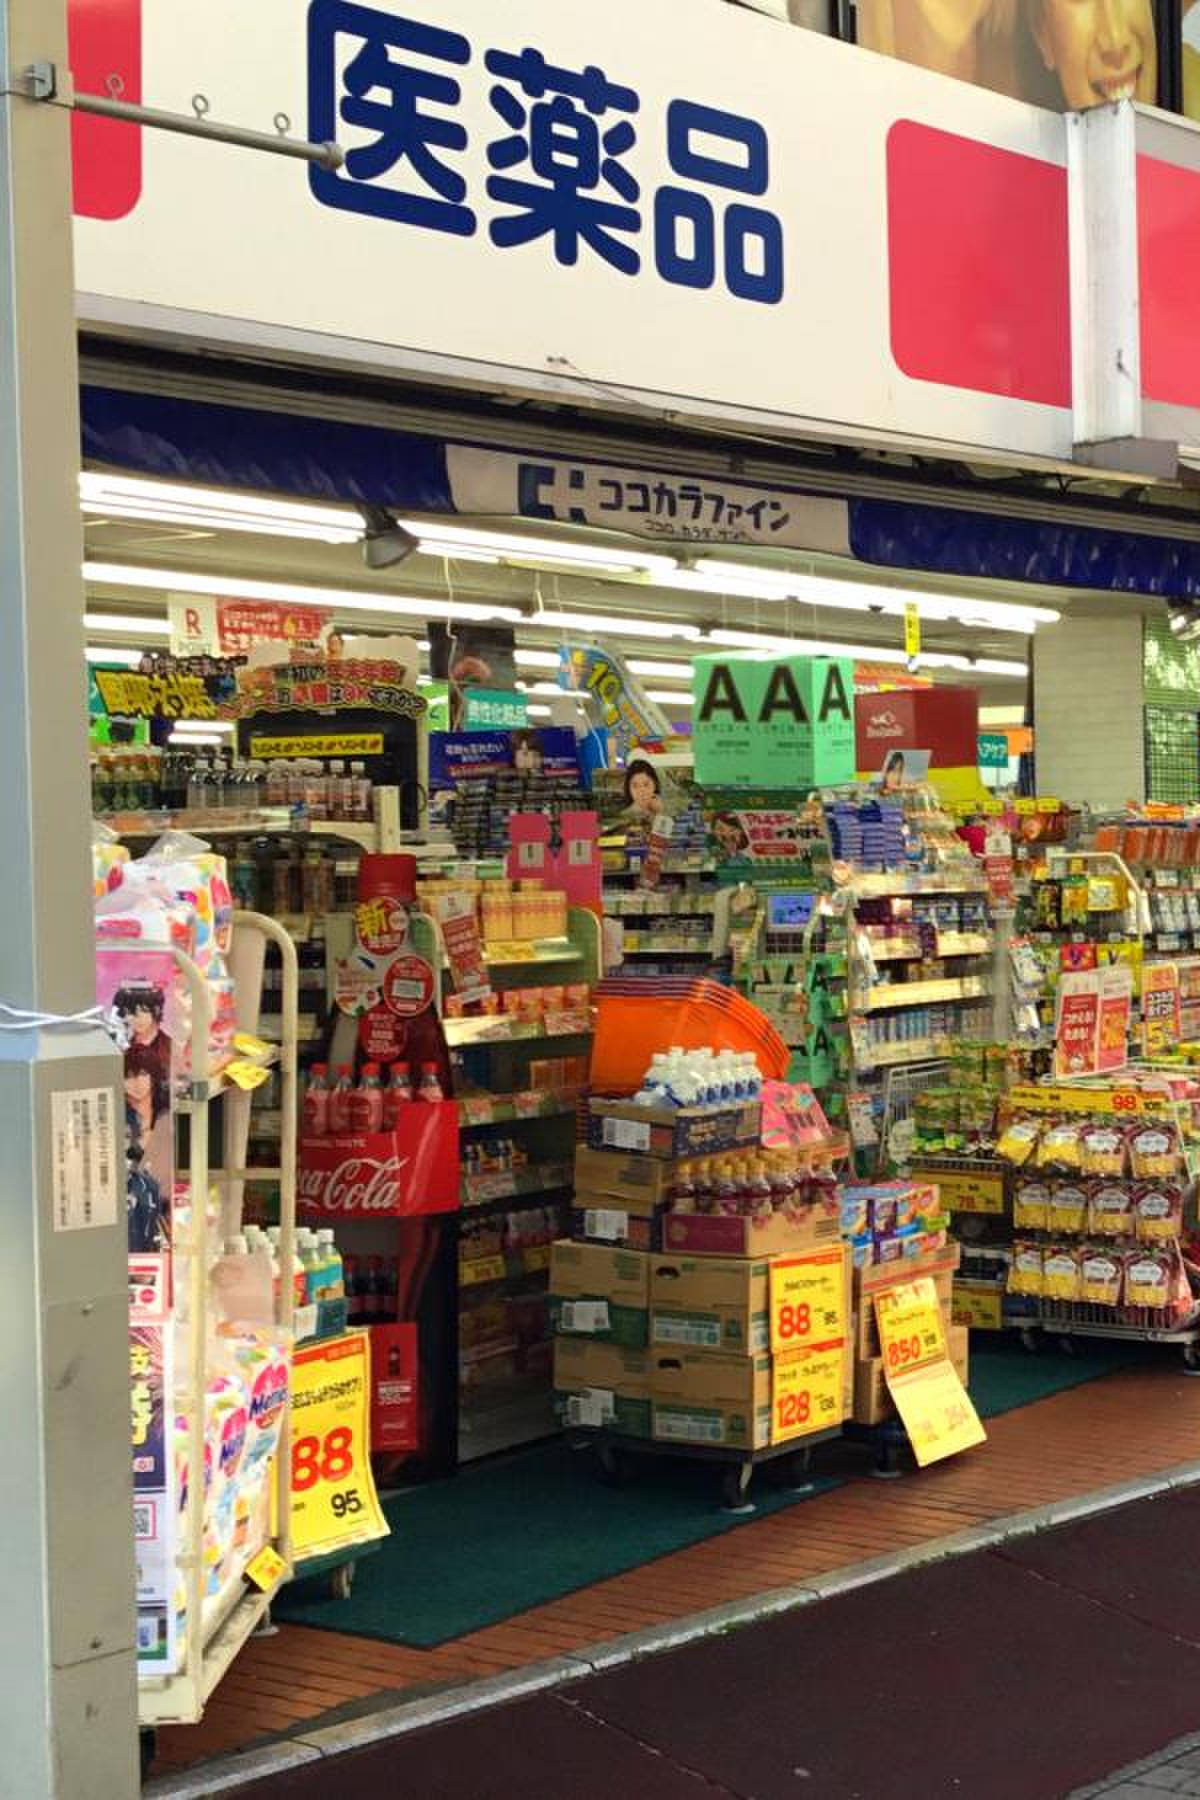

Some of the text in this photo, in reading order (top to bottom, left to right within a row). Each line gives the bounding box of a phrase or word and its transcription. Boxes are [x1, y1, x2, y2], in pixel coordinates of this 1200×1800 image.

[307, 0, 784, 305] 医薬品
[598, 478, 791, 532] ココカラファイン
[1112, 1093, 1137, 1112] 98
[778, 1302, 811, 1340] 88
[887, 1333, 922, 1368] 850
[776, 1389, 811, 1430] 128
[290, 1425, 353, 1493] 88
[331, 1488, 362, 1518] 95
